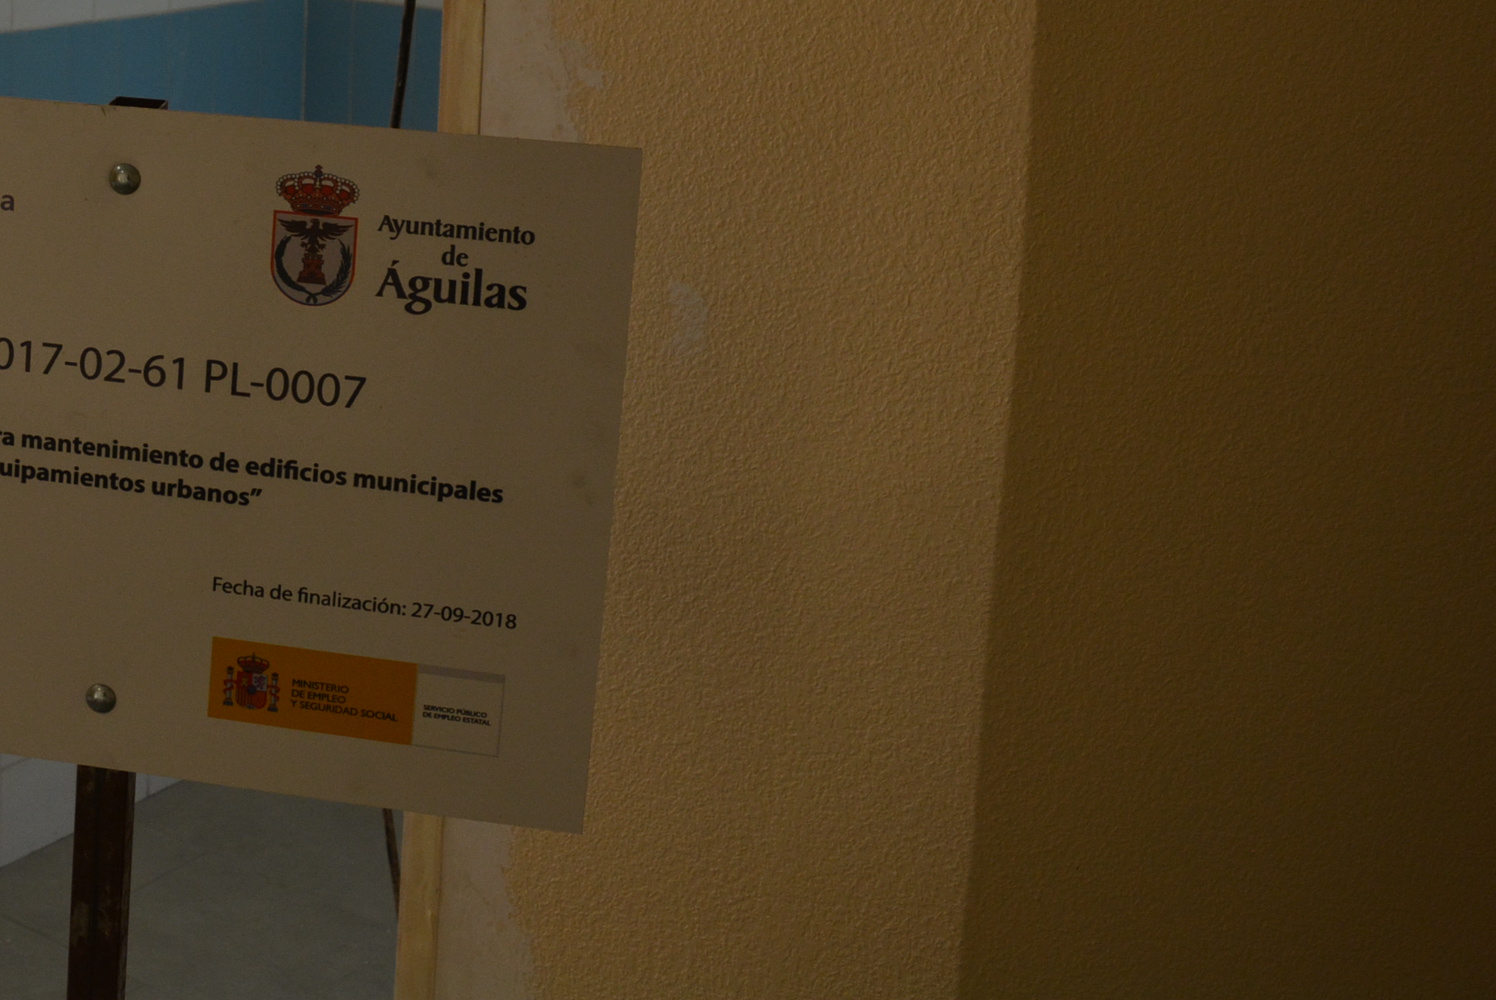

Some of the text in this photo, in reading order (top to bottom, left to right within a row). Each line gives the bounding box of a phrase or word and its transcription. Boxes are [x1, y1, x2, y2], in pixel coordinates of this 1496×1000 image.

[377, 214, 536, 246] Ayuntamiento
[440, 243, 470, 268] de
[374, 259, 528, 316] Águilas
[204, 359, 367, 409] PL-0007
[20, 433, 205, 472] mantenimiento
[208, 451, 241, 474] de
[244, 457, 348, 487] edificios
[352, 472, 504, 504] municipales
[212, 576, 517, 630] Fecha de finalización: 27-09-2018
[292, 679, 349, 694] MINISTERIO
[292, 689, 346, 704] DE EMPLEO
[300, 702, 358, 716] SEGURIDAD
[360, 709, 398, 722] SOCIAL
[423, 704, 455, 714] SERVICIO
[434, 713, 461, 722] EMPLEO
[462, 716, 491, 726] ESTATAL
